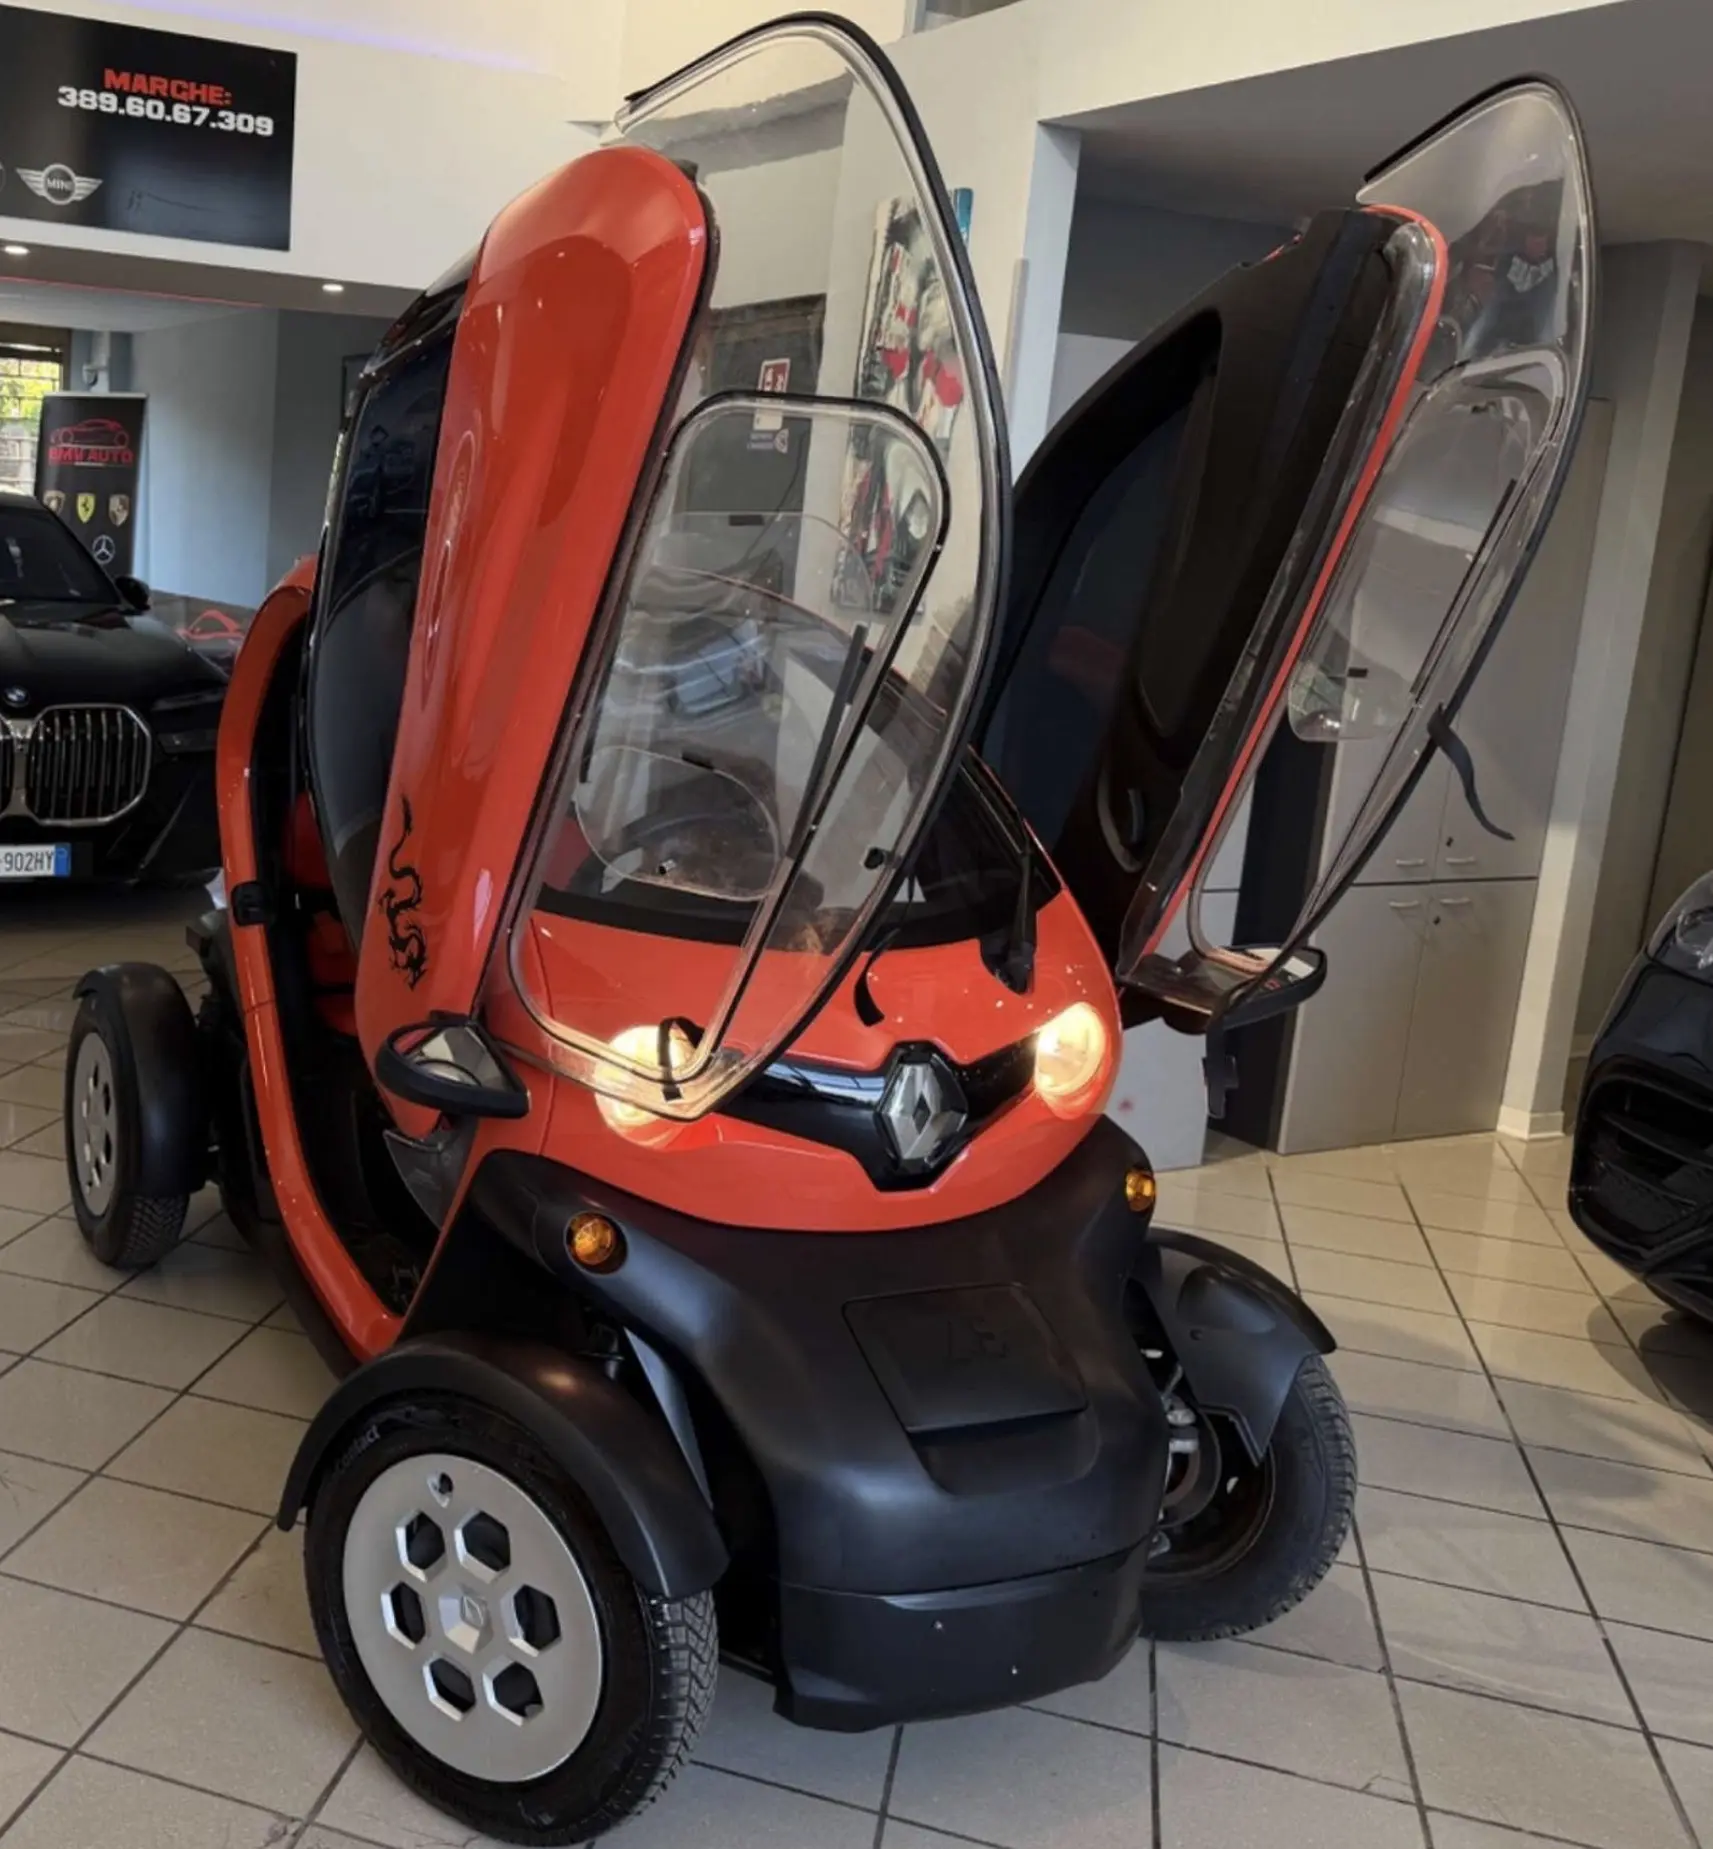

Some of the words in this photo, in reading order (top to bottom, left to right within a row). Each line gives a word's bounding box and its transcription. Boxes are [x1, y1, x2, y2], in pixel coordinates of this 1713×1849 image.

[103, 67, 232, 105] MARCHE:
[57, 85, 274, 137] 389.60.67.309
[87, 449, 134, 463] AUTO
[5, 850, 54, 873] 902HY
